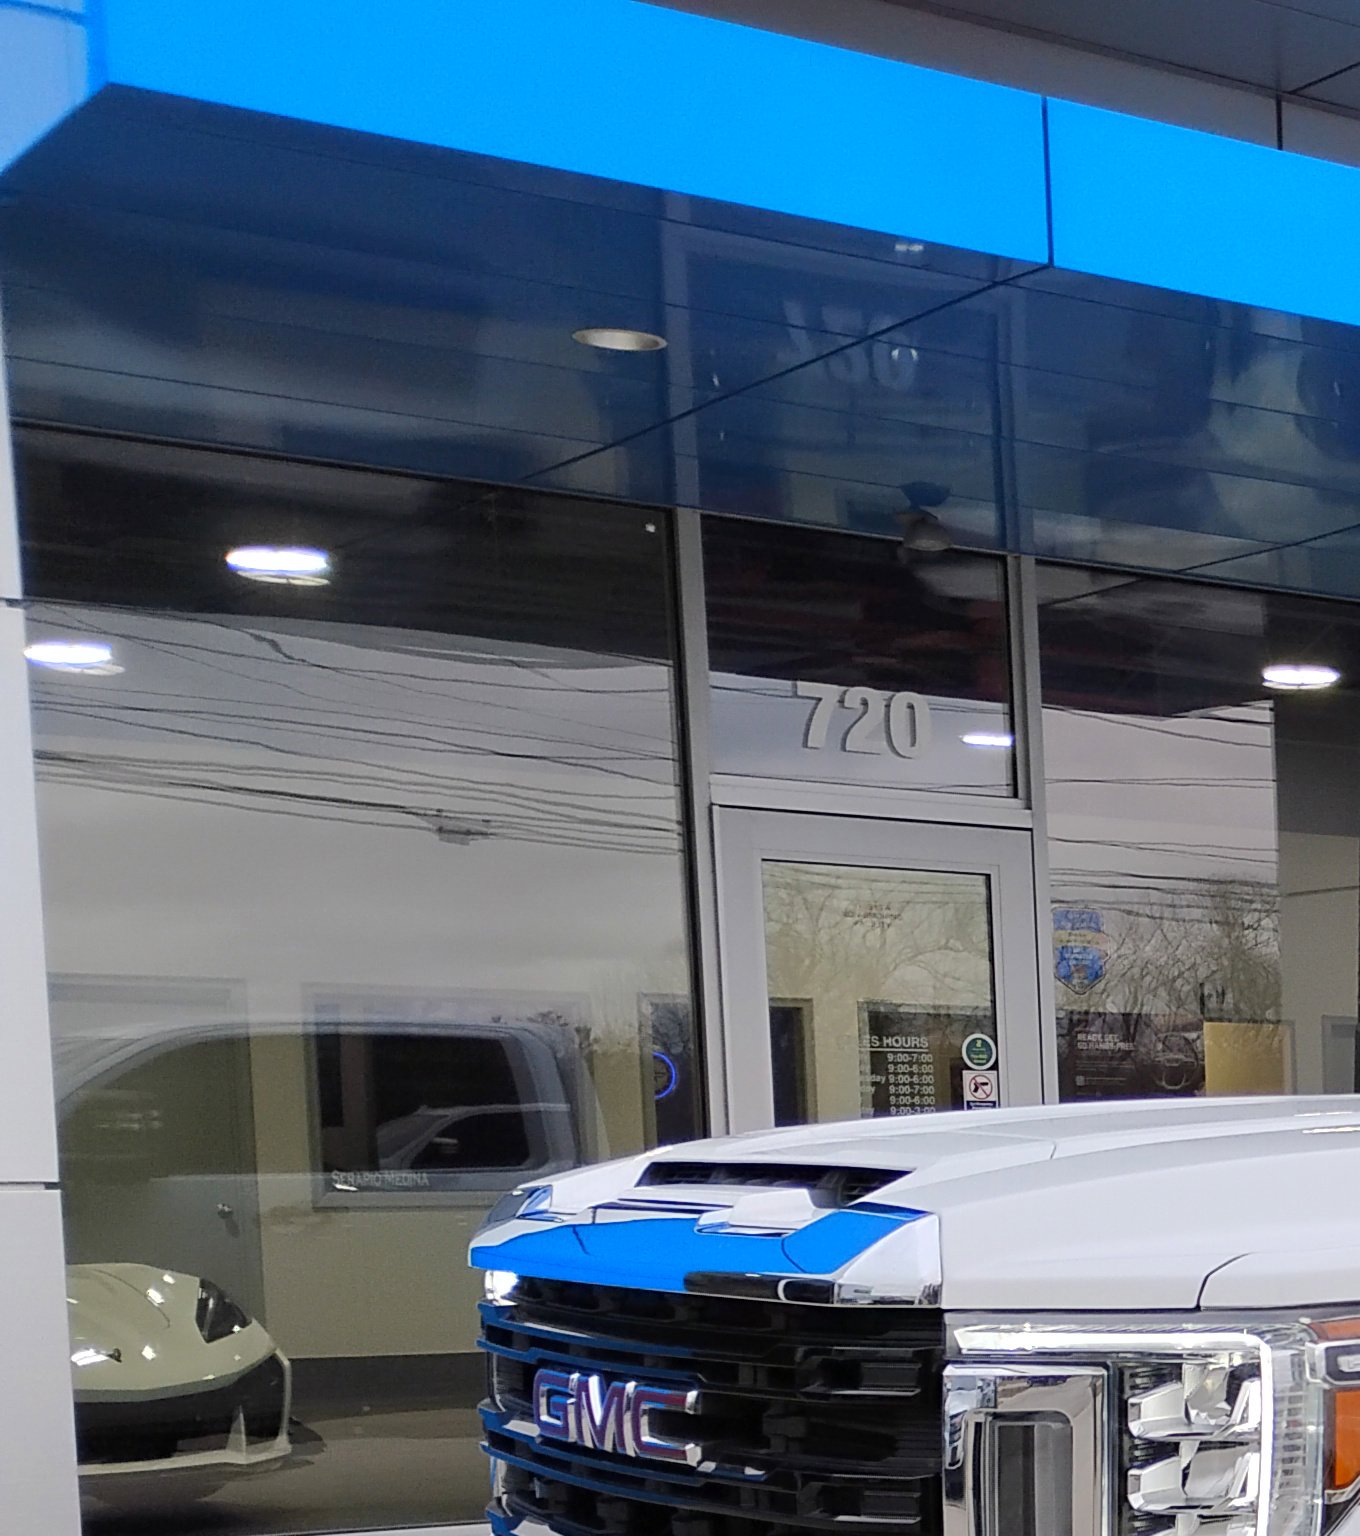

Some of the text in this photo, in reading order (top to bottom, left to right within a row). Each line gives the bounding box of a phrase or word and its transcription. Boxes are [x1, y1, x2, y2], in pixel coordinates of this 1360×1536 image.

[792, 680, 932, 760] 720
[883, 1036, 929, 1048] HOURS
[887, 1053, 933, 1062] 9:00-7:00
[887, 1064, 934, 1073] 9:00-6:00
[888, 1074, 935, 1084] 9:00-6:00
[889, 1085, 935, 1094] 9:00-7:00
[889, 1095, 936, 1105] 9:00-6:00
[890, 1106, 936, 1115] 9:00-3:00
[533, 1368, 702, 1468] GMC
